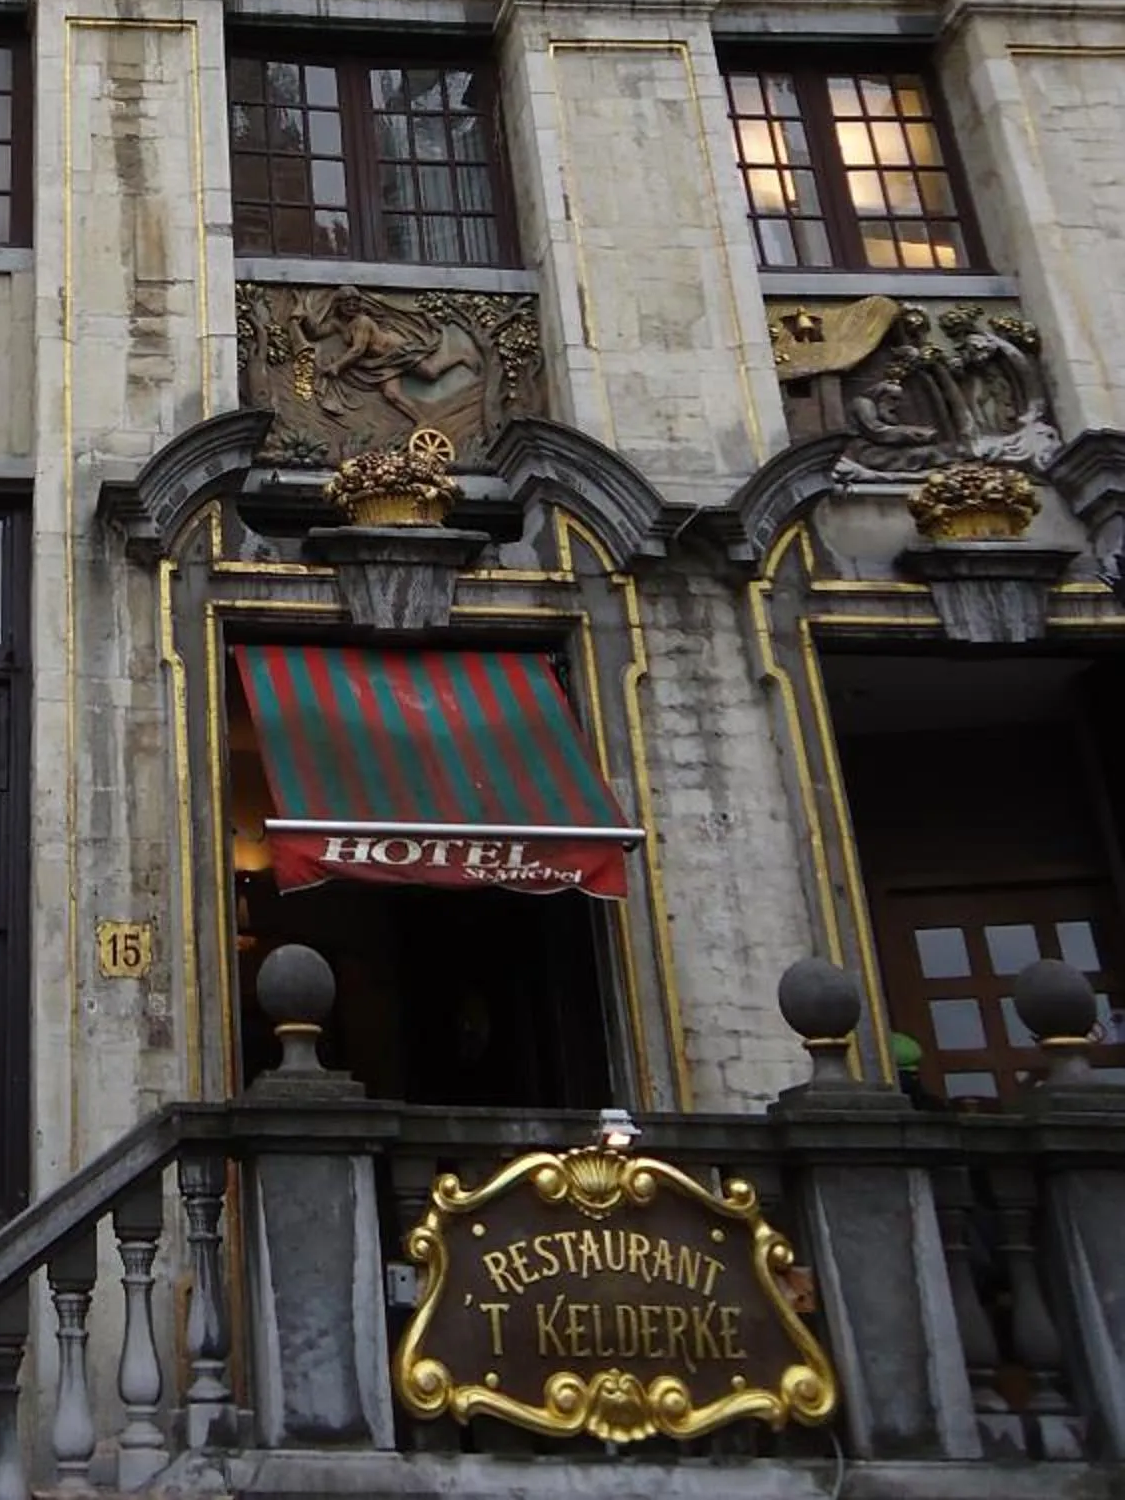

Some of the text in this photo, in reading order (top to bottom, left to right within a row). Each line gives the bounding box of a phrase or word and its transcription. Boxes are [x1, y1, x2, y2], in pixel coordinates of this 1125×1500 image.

[319, 836, 539, 869] HOTEL
[108, 932, 141, 967] 15
[482, 1229, 726, 1296] RESTAURANT
[535, 1293, 748, 1373] KELDERKE
